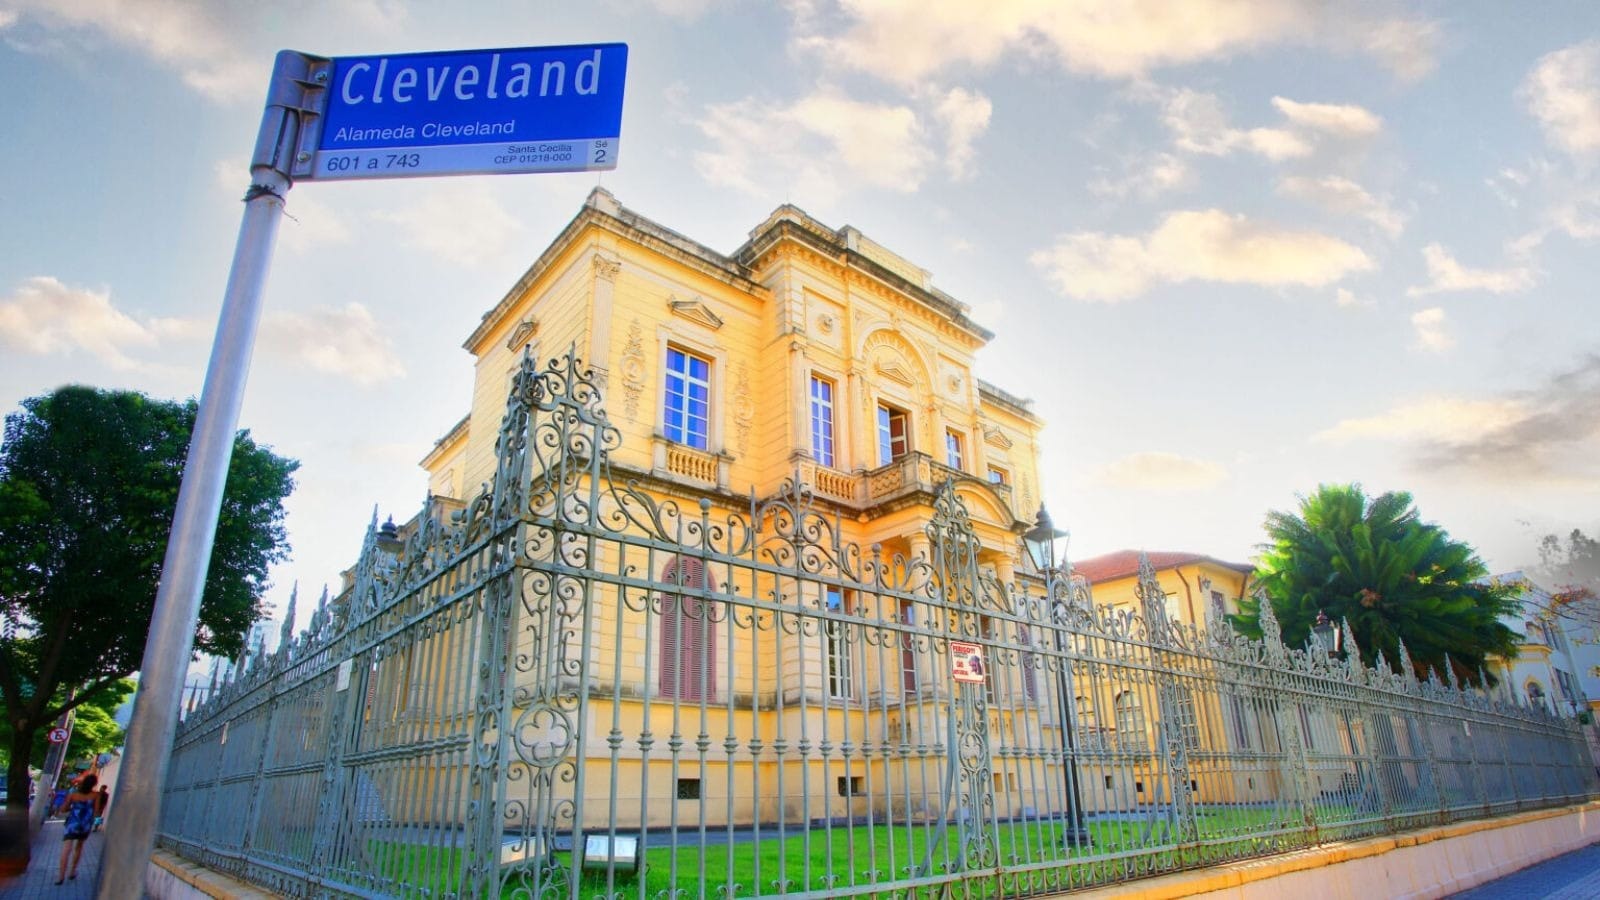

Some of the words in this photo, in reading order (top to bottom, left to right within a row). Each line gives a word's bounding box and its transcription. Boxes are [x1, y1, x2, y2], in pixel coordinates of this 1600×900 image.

[342, 49, 601, 104] Cleveland
[334, 125, 415, 141] Alameda
[421, 120, 515, 138] Cleveland
[508, 145, 535, 154] Santa
[594, 149, 606, 163] 2
[327, 157, 359, 171] 601
[367, 158, 378, 169] a
[386, 153, 420, 168] 743
[494, 155, 517, 164] CEP
[519, 153, 572, 163] 01218-000
